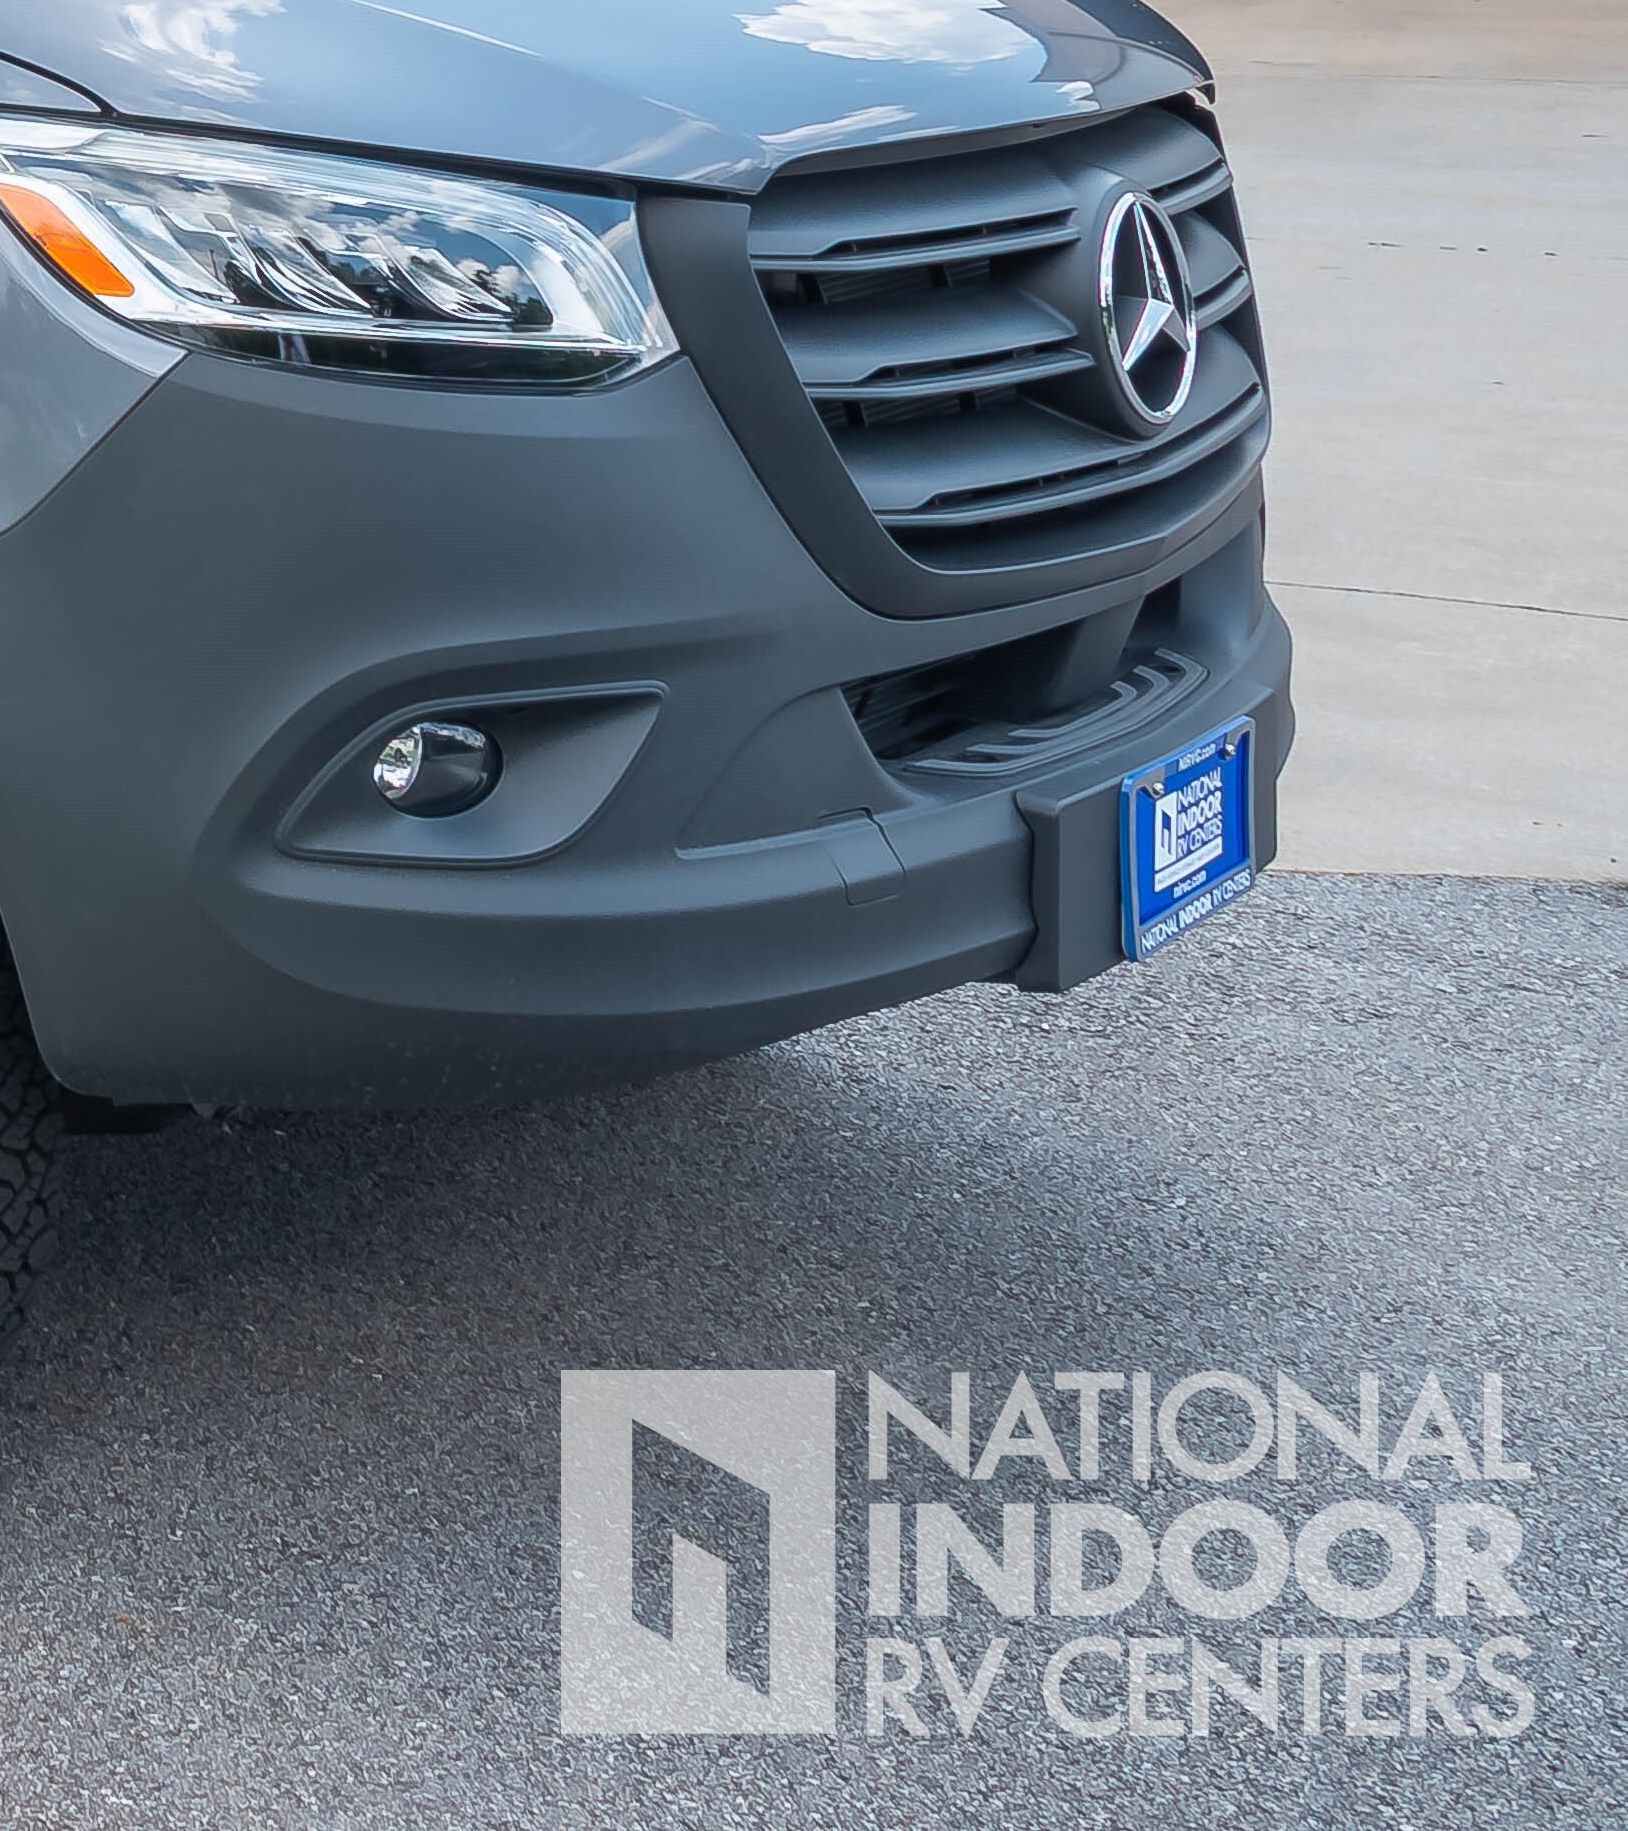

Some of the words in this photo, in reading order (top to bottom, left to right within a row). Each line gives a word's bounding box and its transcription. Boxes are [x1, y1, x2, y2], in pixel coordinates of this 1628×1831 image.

[1178, 767, 1223, 810] NATIONAL
[1178, 791, 1223, 837] INDOOR
[1141, 914, 1179, 954] NATIONAL
[1178, 893, 1213, 929] INDOOR
